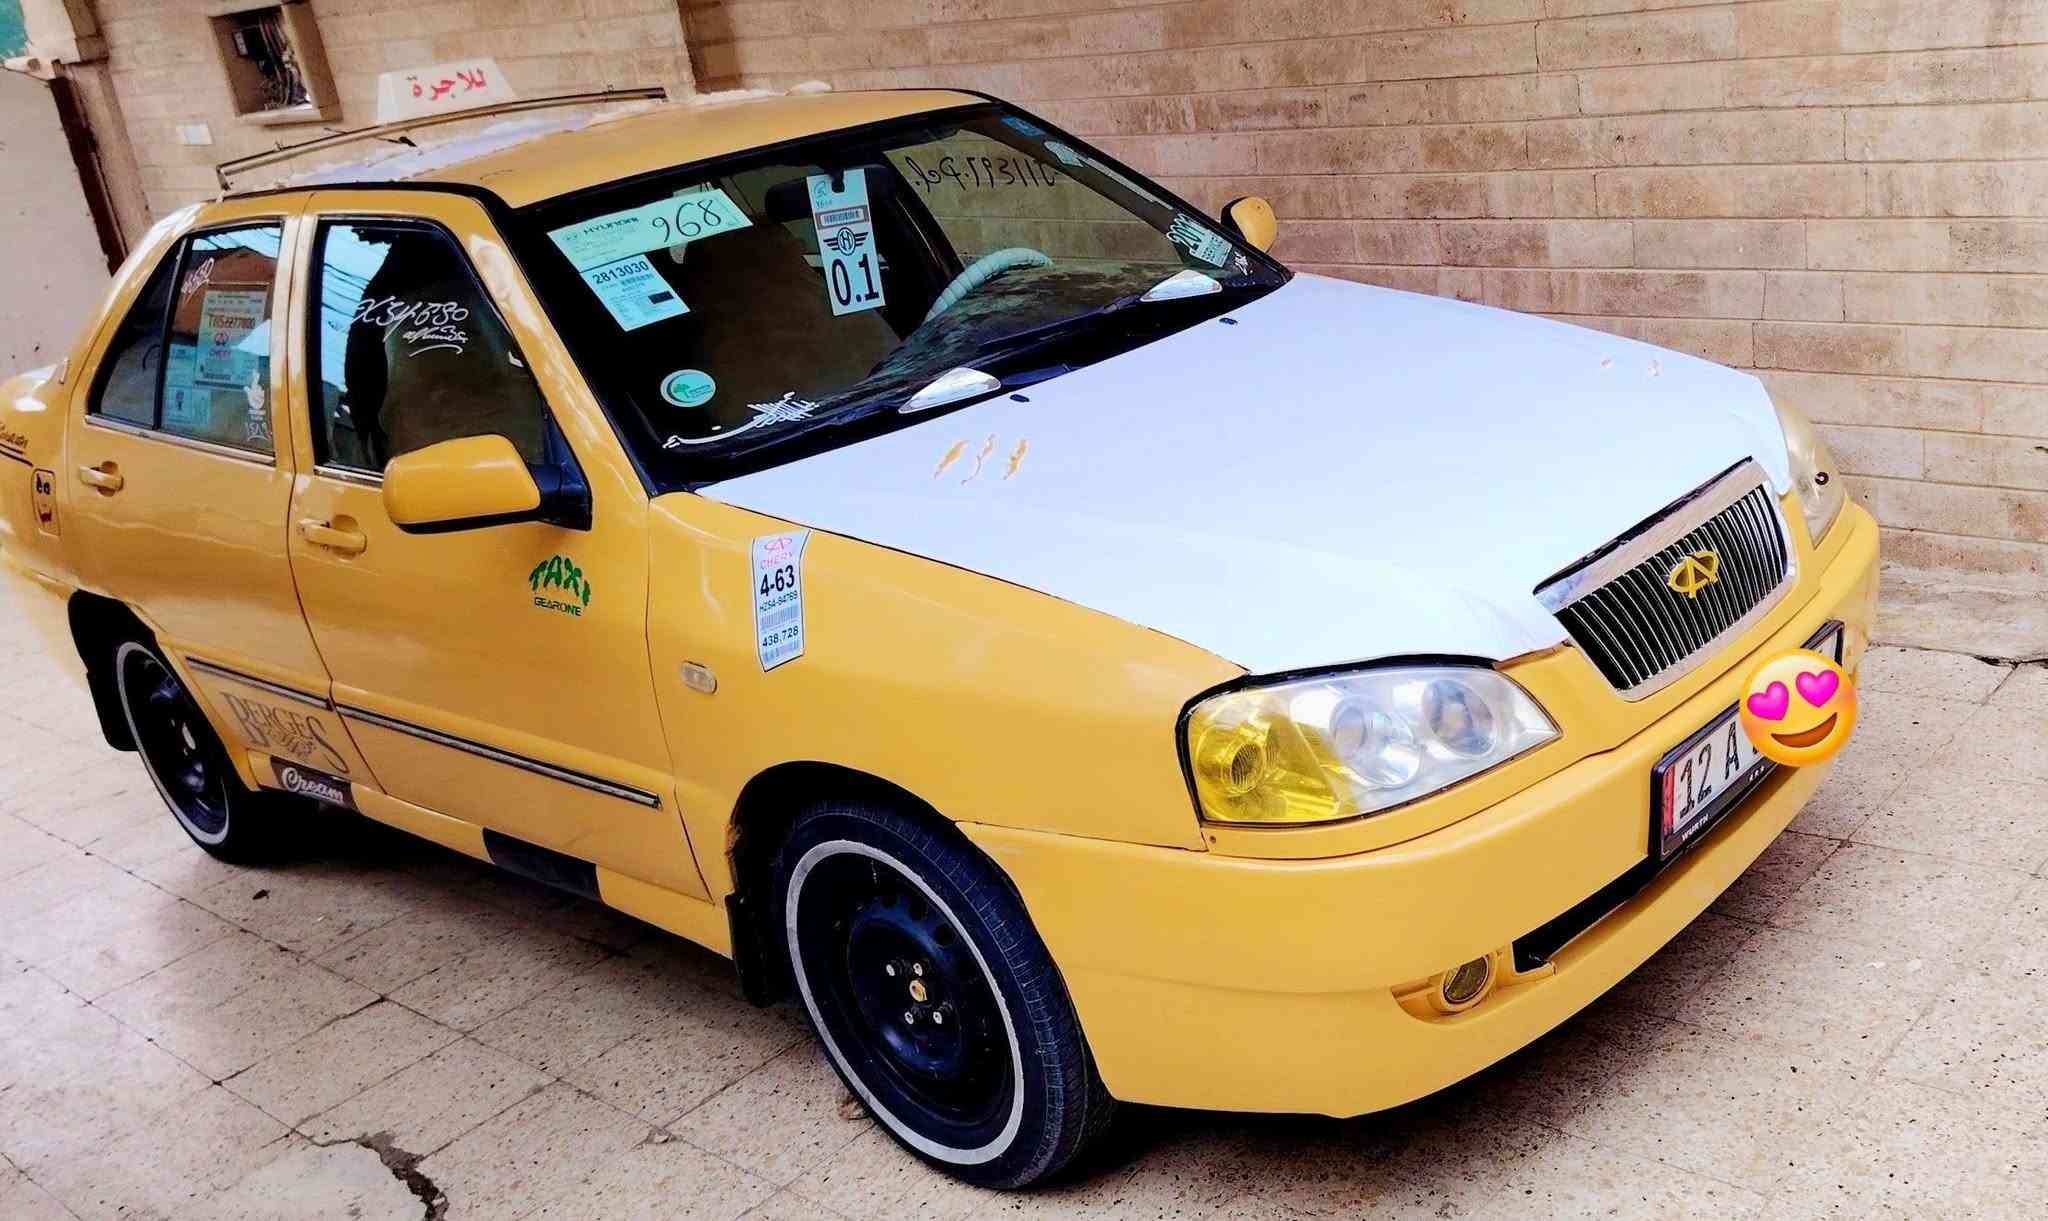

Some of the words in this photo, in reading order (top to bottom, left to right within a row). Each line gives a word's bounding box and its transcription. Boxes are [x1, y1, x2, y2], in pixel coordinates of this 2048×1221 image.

[652, 199, 722, 243] 968
[592, 261, 650, 285] 2813030
[831, 253, 880, 306] 0.1
[760, 564, 795, 597] 4-63
[1679, 743, 1713, 820] 12
[1724, 720, 1741, 780] A
